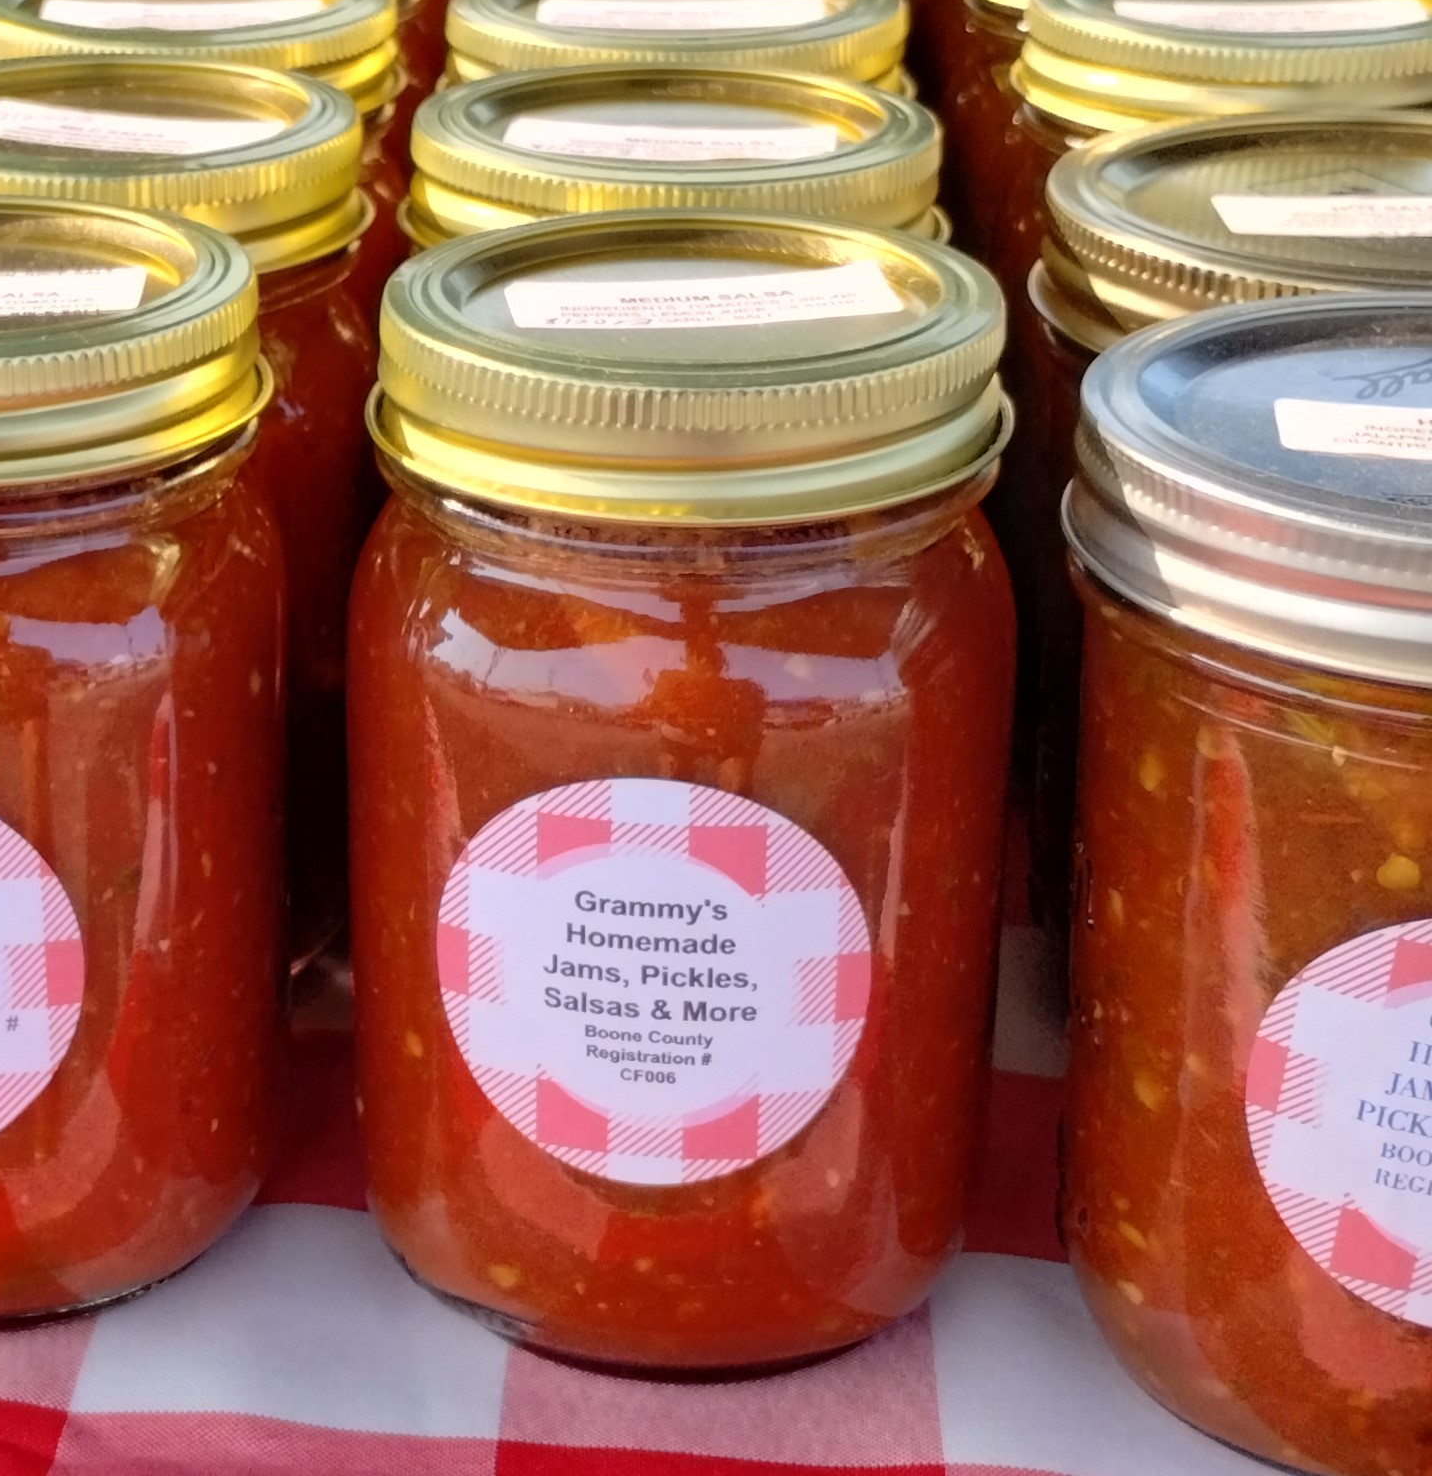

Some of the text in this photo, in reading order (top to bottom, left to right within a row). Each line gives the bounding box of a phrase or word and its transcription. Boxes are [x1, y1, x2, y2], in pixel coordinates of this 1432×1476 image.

[574, 890, 728, 926] Grammy's
[566, 922, 737, 955] Homemade
[543, 954, 758, 992] Jams, Pickles,
[544, 986, 758, 1022] Salsas & More
[5, 1014, 20, 1032] #
[584, 1024, 714, 1049] Boone County
[585, 1044, 713, 1066] Registration #
[619, 1067, 677, 1084] CF006
